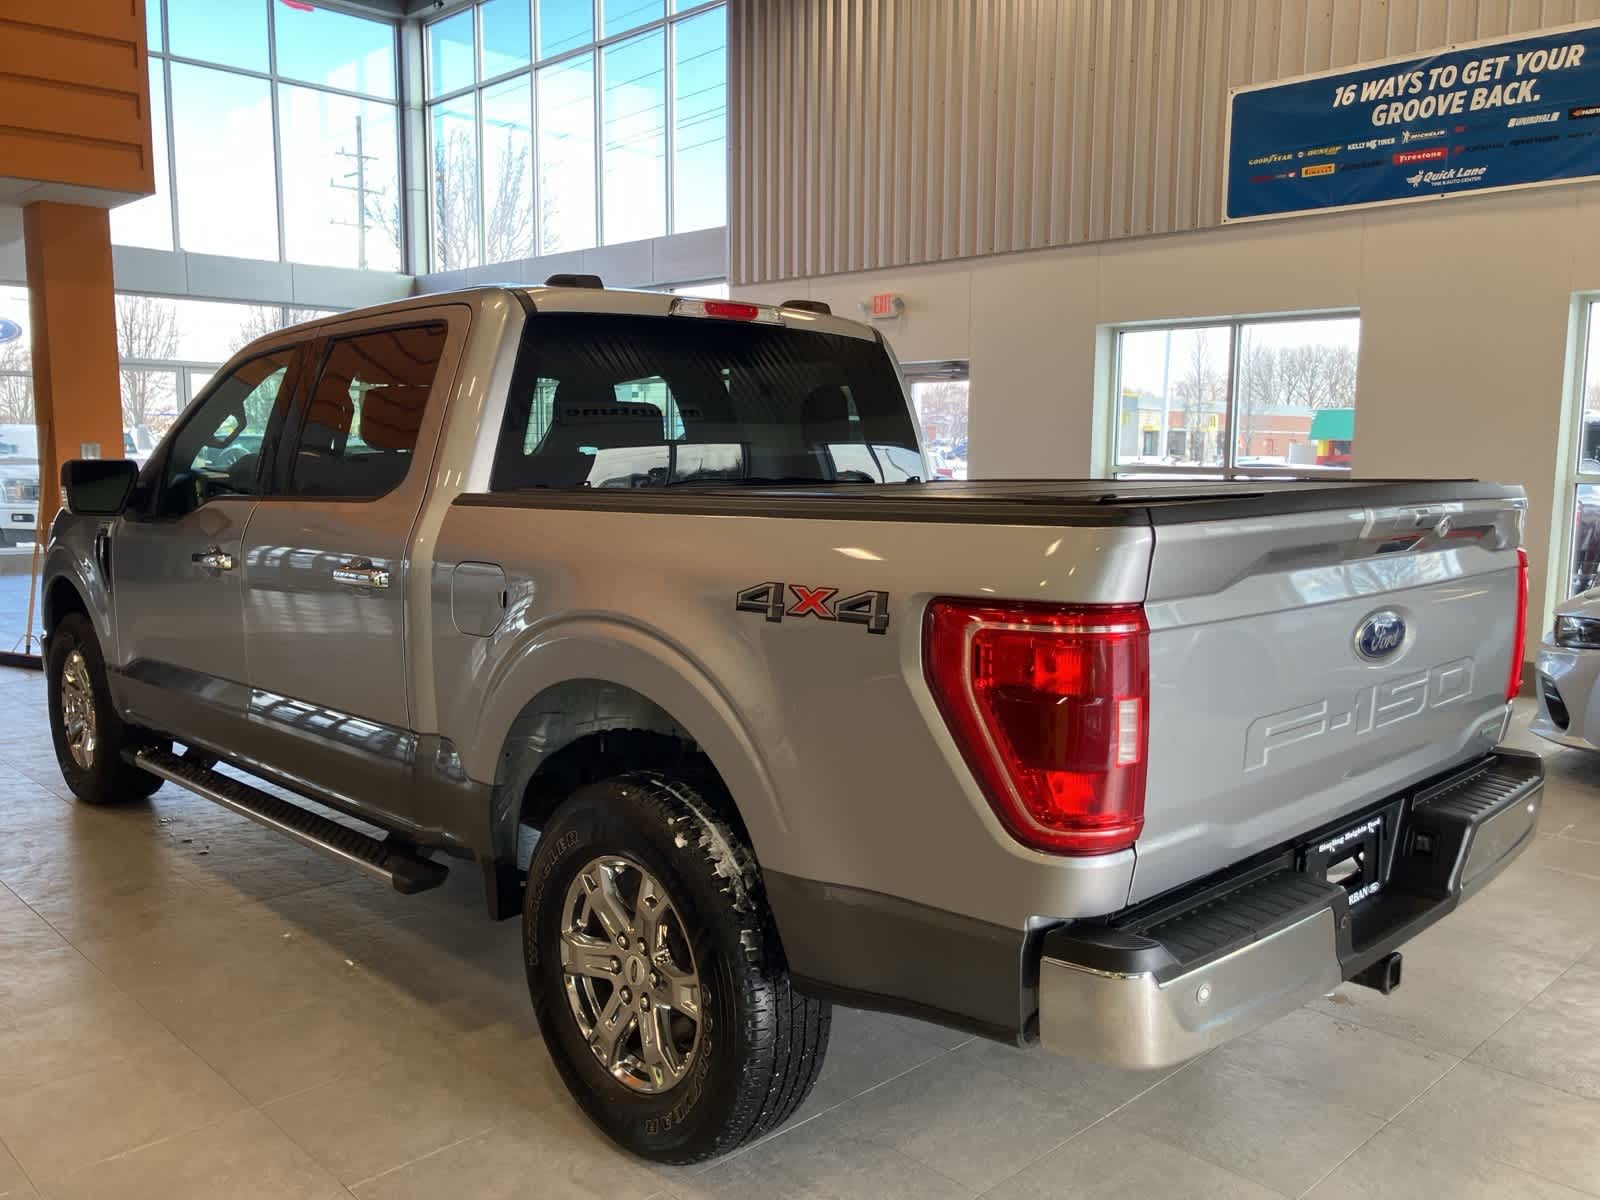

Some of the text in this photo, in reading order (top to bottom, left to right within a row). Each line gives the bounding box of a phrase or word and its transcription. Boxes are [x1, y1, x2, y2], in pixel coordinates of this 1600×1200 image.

[1333, 44, 1585, 108] 16 WAYS TO GET YOUR
[1371, 91, 1467, 126] GROOVE
[1469, 79, 1541, 111] BACK.
[1347, 141, 1365, 151] KELLY
[1248, 153, 1293, 166] GOODYEAR
[1424, 167, 1487, 183] Quick Lane
[1461, 175, 1482, 184] CENTER
[1370, 624, 1400, 651] Ford
[1243, 655, 1475, 773] F-150
